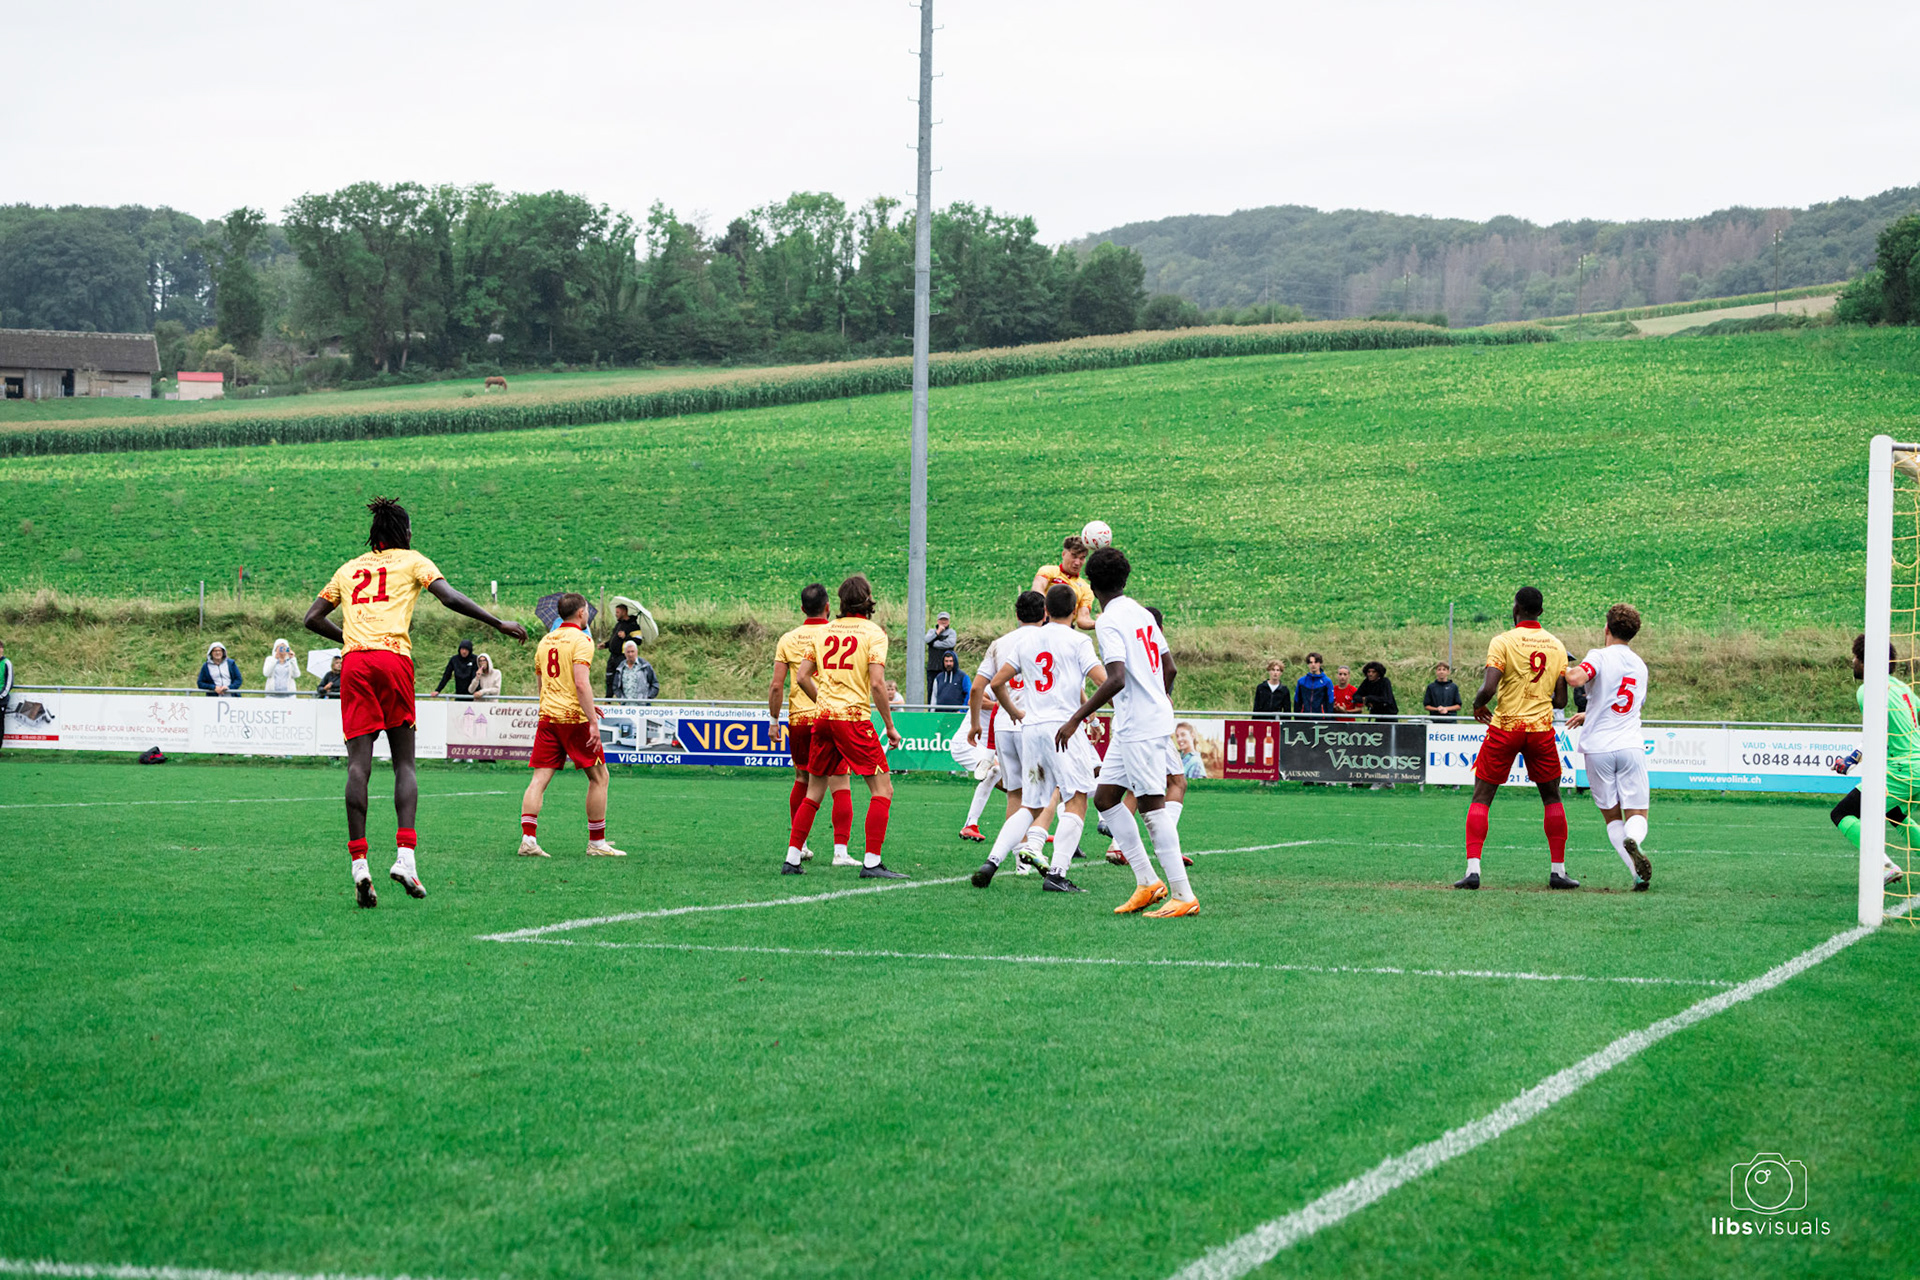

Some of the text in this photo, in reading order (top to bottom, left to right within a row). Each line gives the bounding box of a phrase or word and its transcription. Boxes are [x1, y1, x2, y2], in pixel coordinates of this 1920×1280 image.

[351, 567, 390, 605] 21
[823, 635, 858, 670] 22
[1136, 625, 1160, 675] 16
[547, 648, 560, 678] 8
[1529, 650, 1547, 683] 9
[1034, 651, 1056, 695] 3
[1611, 676, 1637, 716] 5
[217, 700, 287, 724] PERUSSET
[489, 706, 538, 717] Centre Co
[600, 706, 623, 715] ortes
[625, 707, 637, 716] de
[638, 709, 673, 717] garages
[679, 708, 705, 717] Portes
[706, 709, 756, 718] industrielles
[72, 724, 84, 732] BUT
[204, 724, 314, 742] PARATONNERRES
[499, 732, 508, 740] La
[898, 732, 952, 751] vaudo
[1429, 731, 1487, 743] RÉGIE IMMO
[451, 747, 465, 756] 021
[467, 748, 481, 757] 866
[483, 748, 492, 757] 71
[1742, 741, 1766, 750] VAUD
[1771, 742, 1802, 751] VALAIS
[1809, 743, 1854, 752] FRIBOURG
[618, 752, 681, 764] VIGLINO.CH
[744, 756, 763, 766] 024
[766, 757, 783, 767] 441
[1650, 758, 1707, 766] INFORMATIQUE
[1752, 753, 1790, 766] 0848
[1792, 754, 1821, 767] 444
[1689, 776, 1762, 785] www.evolink.ch
